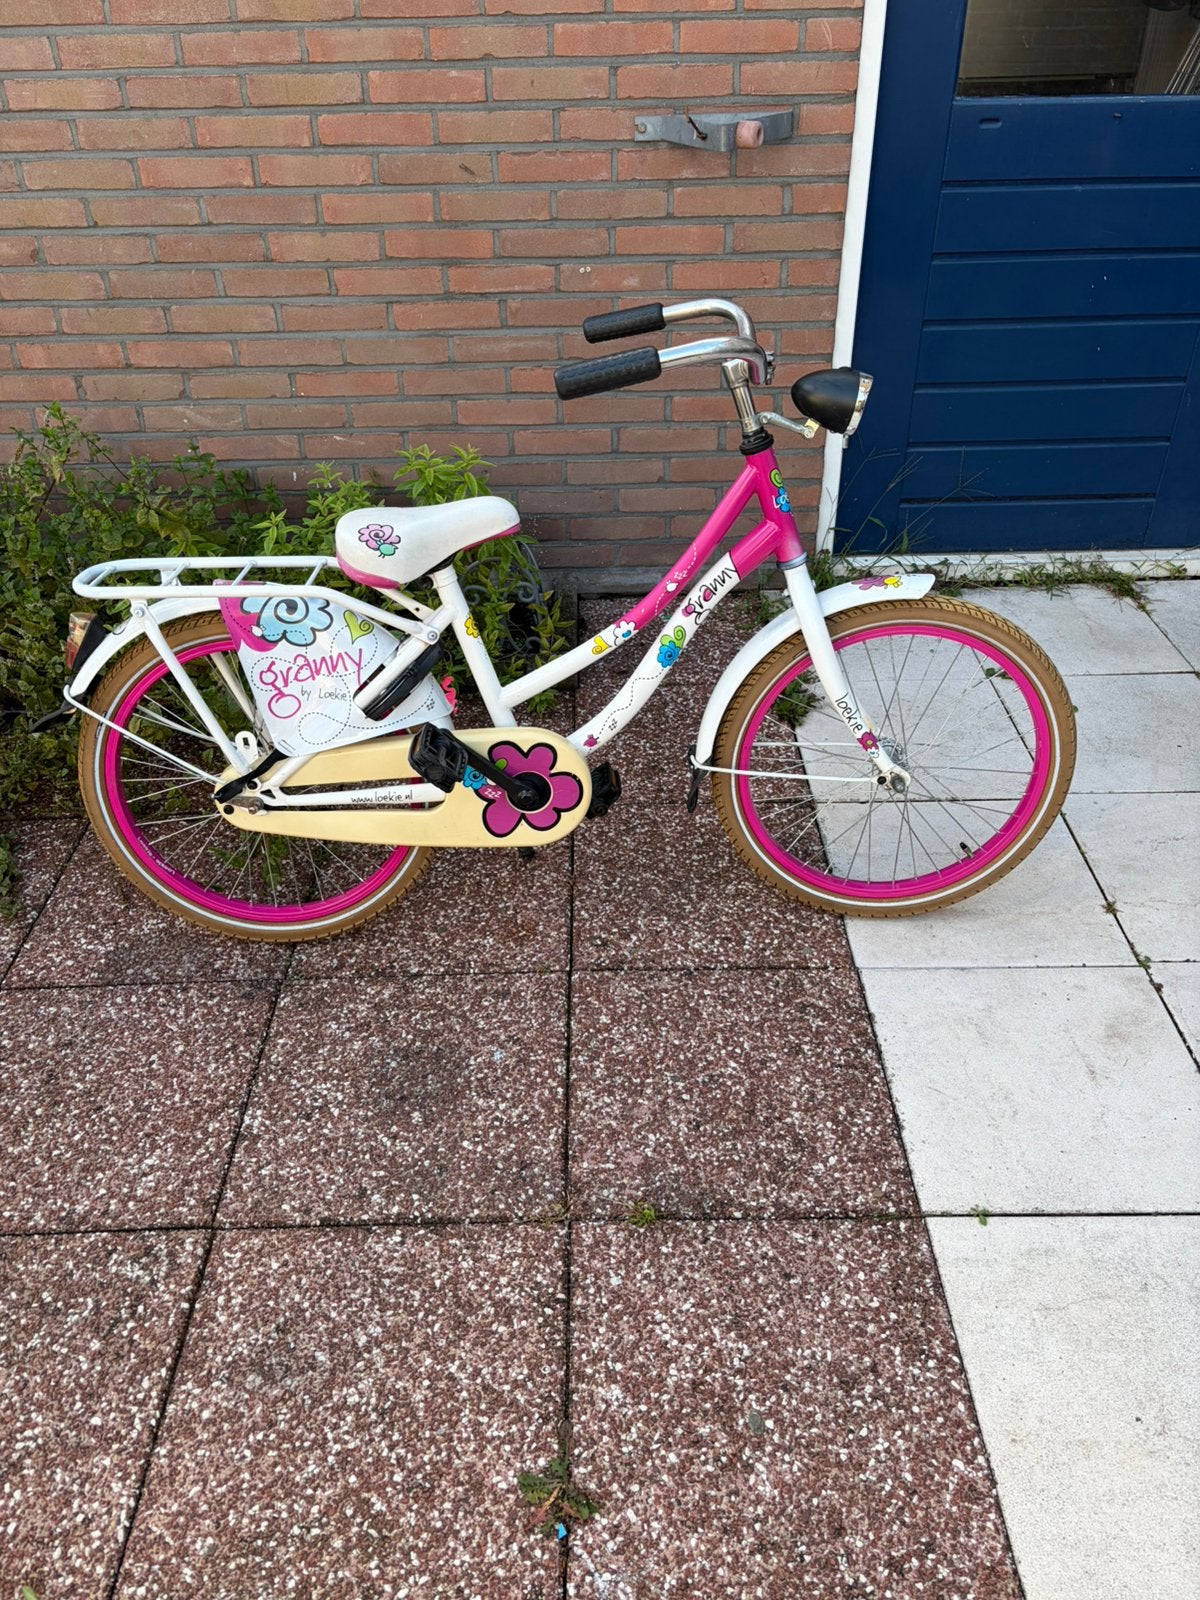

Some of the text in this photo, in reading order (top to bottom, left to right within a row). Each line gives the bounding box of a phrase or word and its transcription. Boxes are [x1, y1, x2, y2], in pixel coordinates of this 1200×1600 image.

[259, 648, 363, 718] granny
[301, 684, 348, 701] by Loekie
[834, 692, 864, 734] loekie
